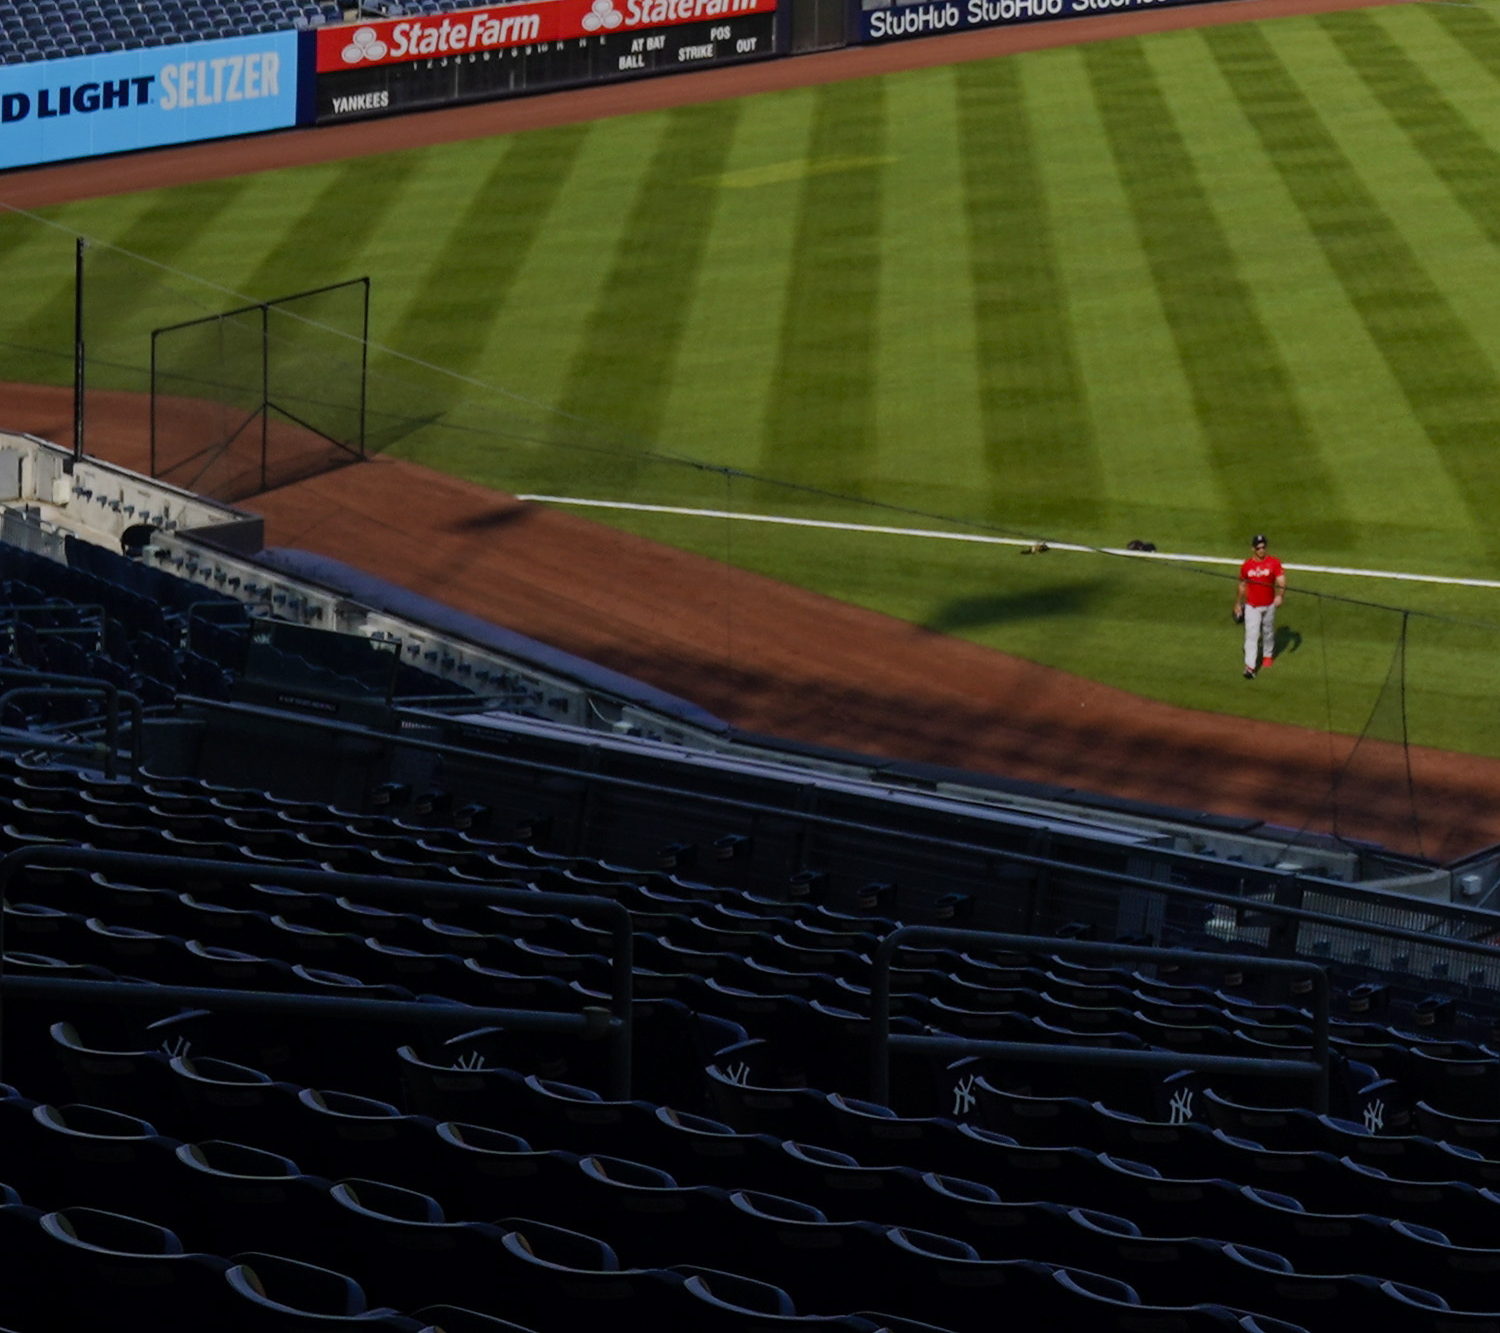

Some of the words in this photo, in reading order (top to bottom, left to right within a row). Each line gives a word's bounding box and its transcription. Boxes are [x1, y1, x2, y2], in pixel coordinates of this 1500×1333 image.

[870, 4, 959, 38] StubHub
[710, 25, 731, 41] POS
[632, 39, 645, 53] AT
[647, 36, 666, 52] BAT
[678, 44, 714, 62] STRIKE
[736, 38, 757, 53] OUT
[618, 55, 645, 71] BALL
[37, 76, 155, 119] LIGHT
[160, 51, 280, 111] SELTZER
[332, 91, 389, 113] YANKEES
